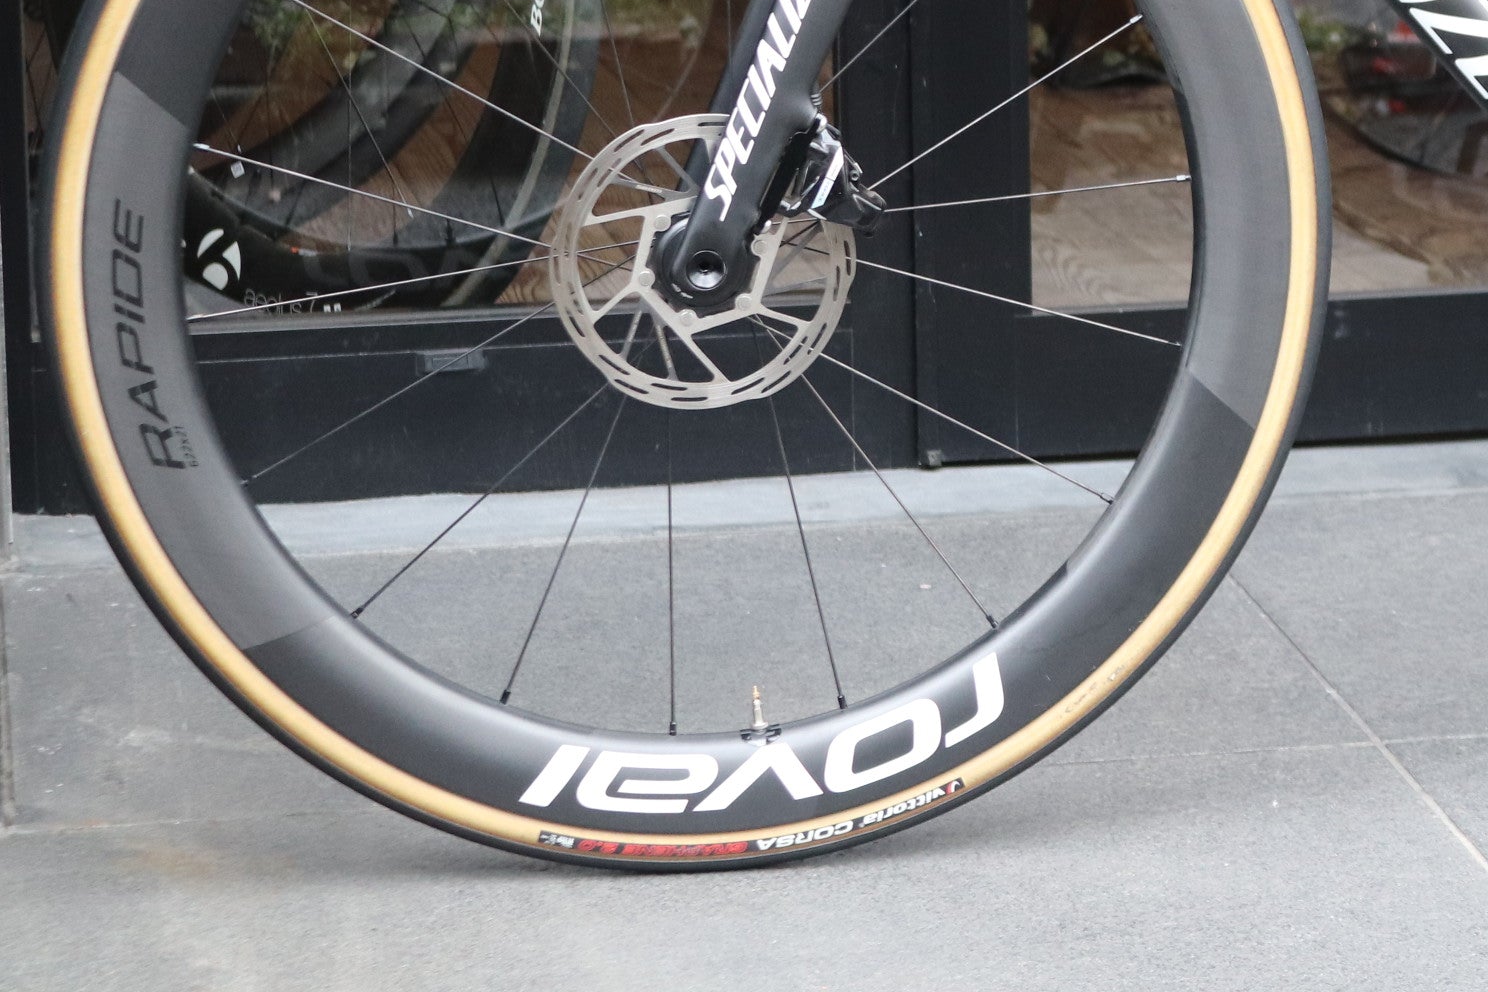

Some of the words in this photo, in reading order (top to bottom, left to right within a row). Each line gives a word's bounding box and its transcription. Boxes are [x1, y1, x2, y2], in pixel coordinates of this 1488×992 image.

[112, 198, 187, 469] RAPIDE
[518, 651, 1006, 814] roval
[756, 820, 854, 851] CORSA
